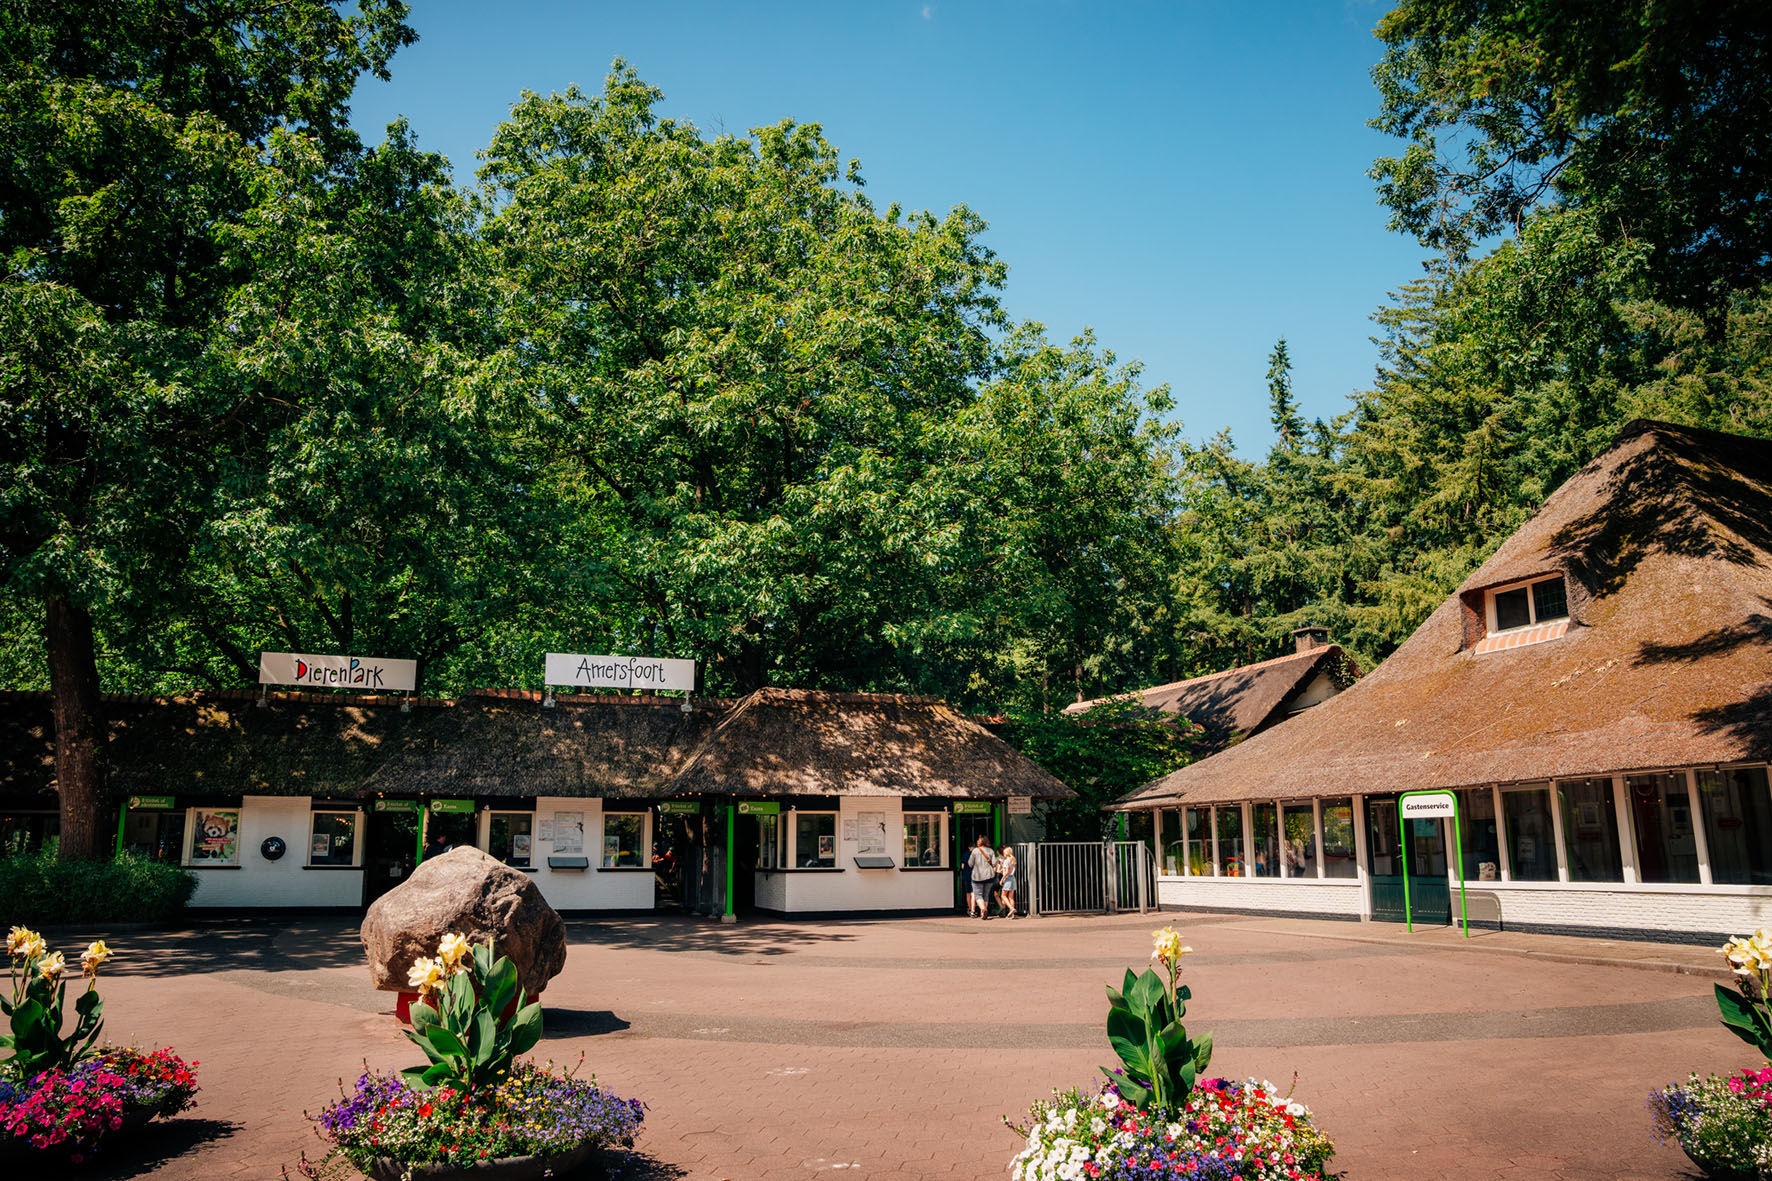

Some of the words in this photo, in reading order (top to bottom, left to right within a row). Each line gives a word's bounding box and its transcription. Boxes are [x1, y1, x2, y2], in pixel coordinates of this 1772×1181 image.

[295, 656, 384, 687] DierenPark
[575, 657, 666, 687] Amersfoort
[1406, 802, 1449, 810] Gastenservice
